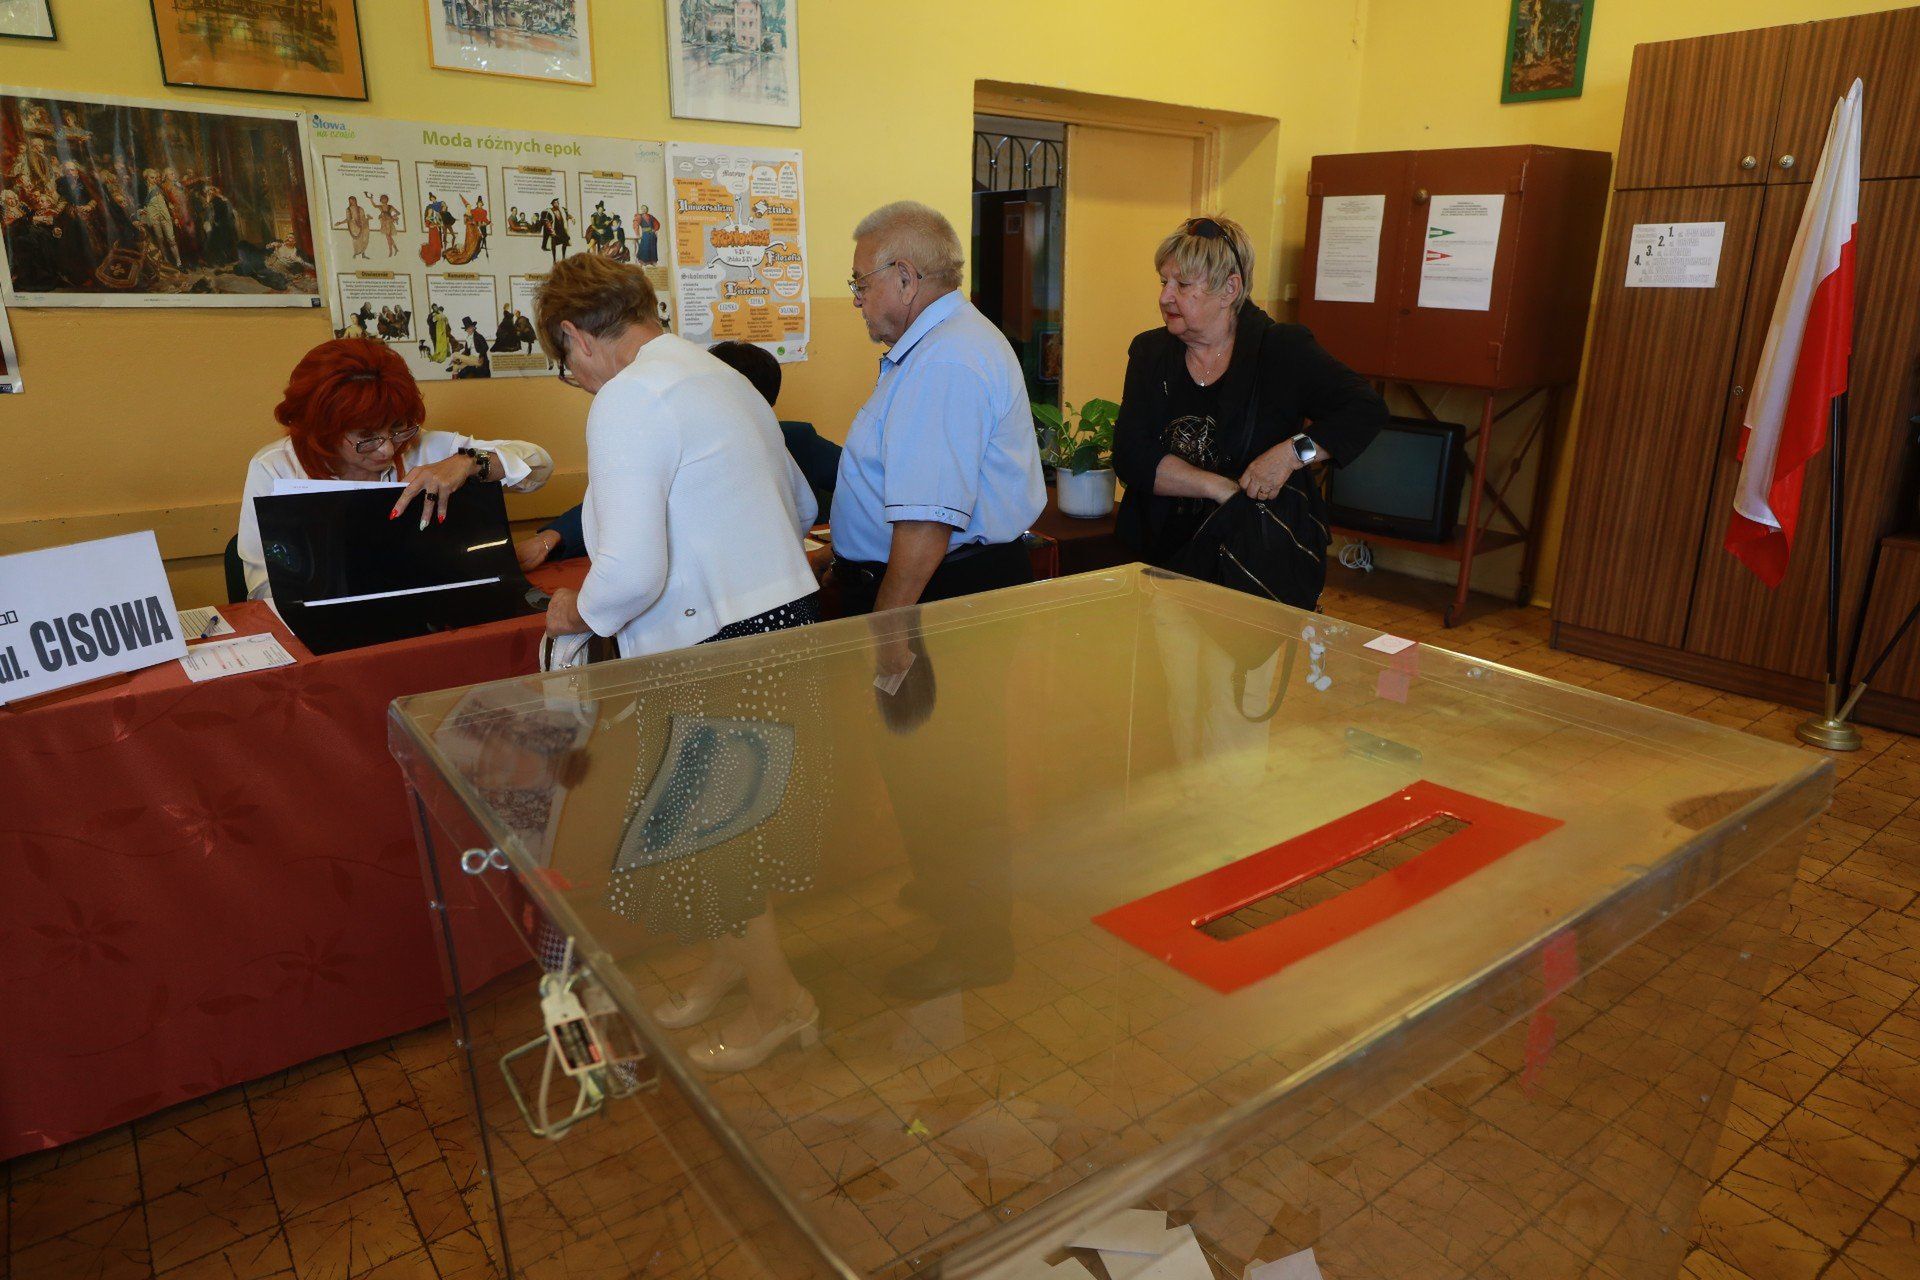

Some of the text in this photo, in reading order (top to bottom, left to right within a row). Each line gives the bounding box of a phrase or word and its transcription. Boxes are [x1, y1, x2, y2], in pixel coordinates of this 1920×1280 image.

[423, 130, 582, 158] Moda różnych epok
[752, 199, 793, 218] Sztuka
[1668, 226, 1674, 237] 1.
[1657, 235, 1665, 246] 2.
[765, 250, 802, 267] Filozofia
[1645, 245, 1653, 256] 3.
[1634, 254, 1641, 265] 4.
[724, 281, 770, 299] Literatura
[30, 596, 173, 672] CISOWA
